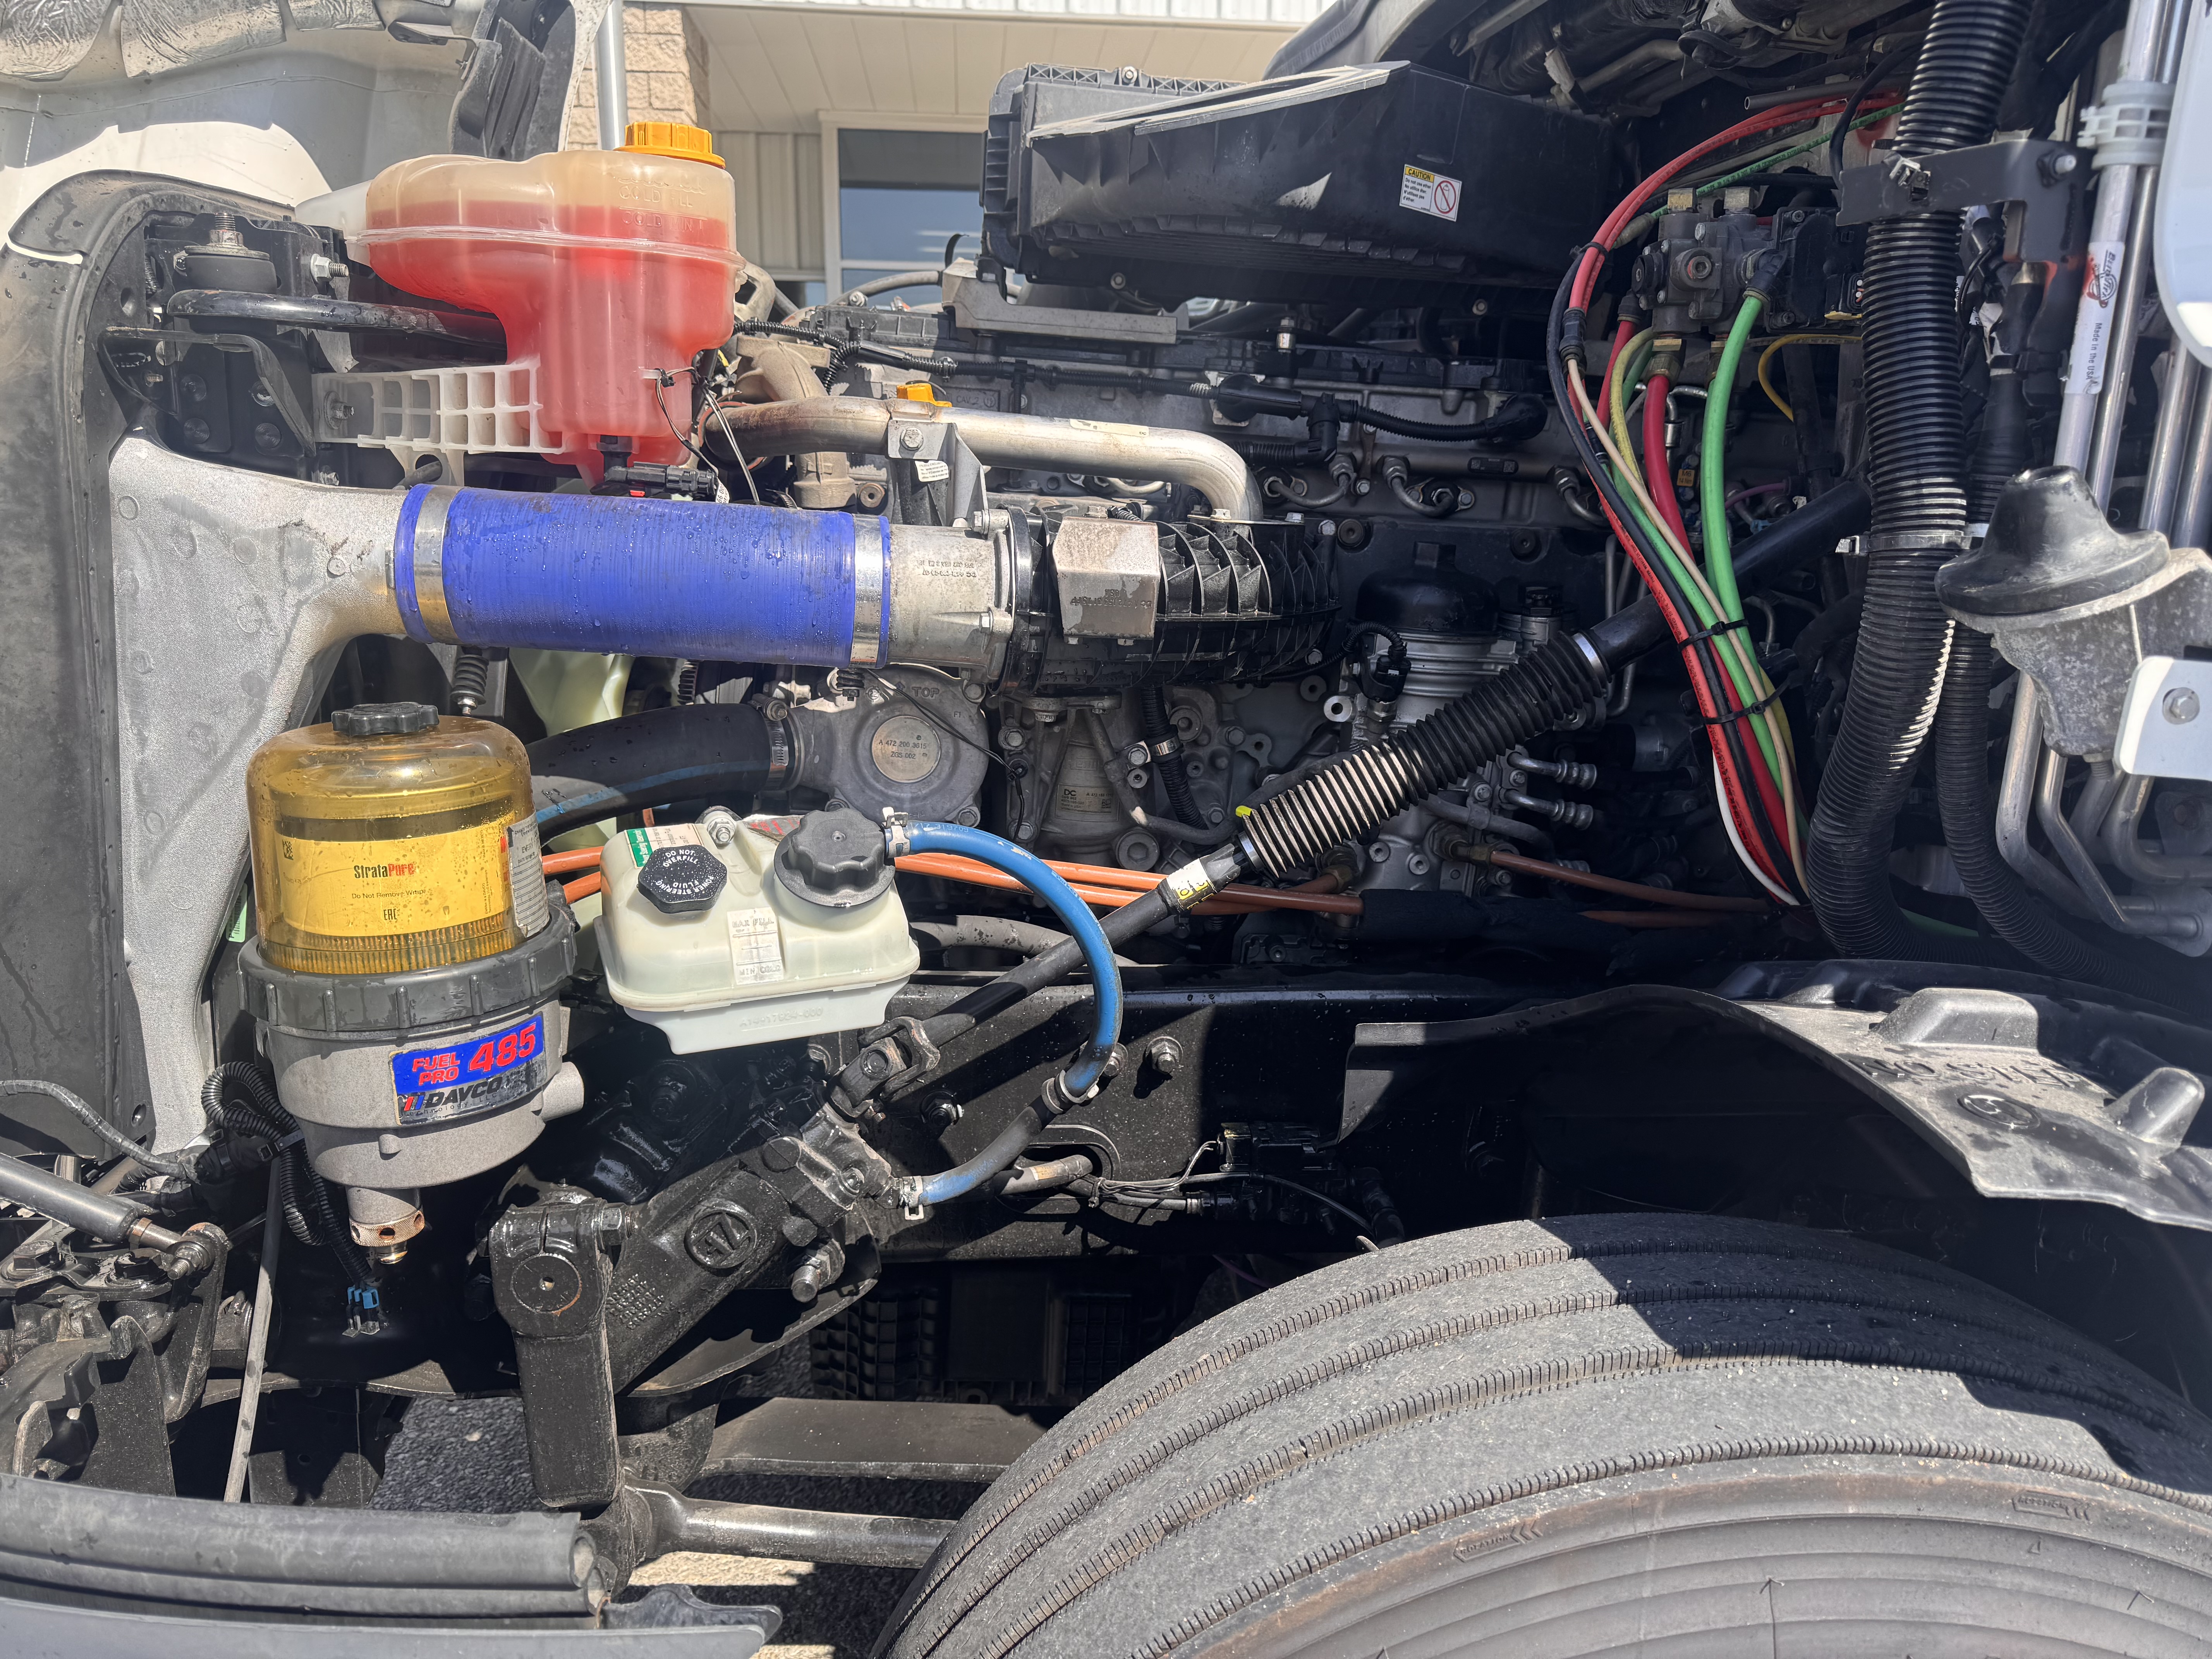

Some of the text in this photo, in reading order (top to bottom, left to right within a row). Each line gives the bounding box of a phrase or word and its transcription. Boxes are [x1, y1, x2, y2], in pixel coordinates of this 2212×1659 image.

[1408, 169, 1431, 180] CAUTION
[620, 185, 661, 203] COLD
[622, 211, 662, 228] COLD
[2092, 323, 2102, 342] Made
[2086, 366, 2095, 380] USA
[912, 686, 939, 698] TOP
[522, 842, 534, 854] EVERY
[663, 855, 699, 867] OVERFILL
[656, 875, 714, 895] POWER STEERING
[673, 879, 699, 888] FLUID
[760, 965, 781, 974] COLD
[469, 1022, 536, 1073] 485
[412, 1052, 460, 1072] FUEL
[418, 1066, 459, 1086] PRO
[1847, 1060, 2081, 1087] NO STEP
[425, 1076, 503, 1109] DAVCO
[479, 1092, 497, 1102] LLC
[1460, 1533, 1509, 1554] ROTATION
